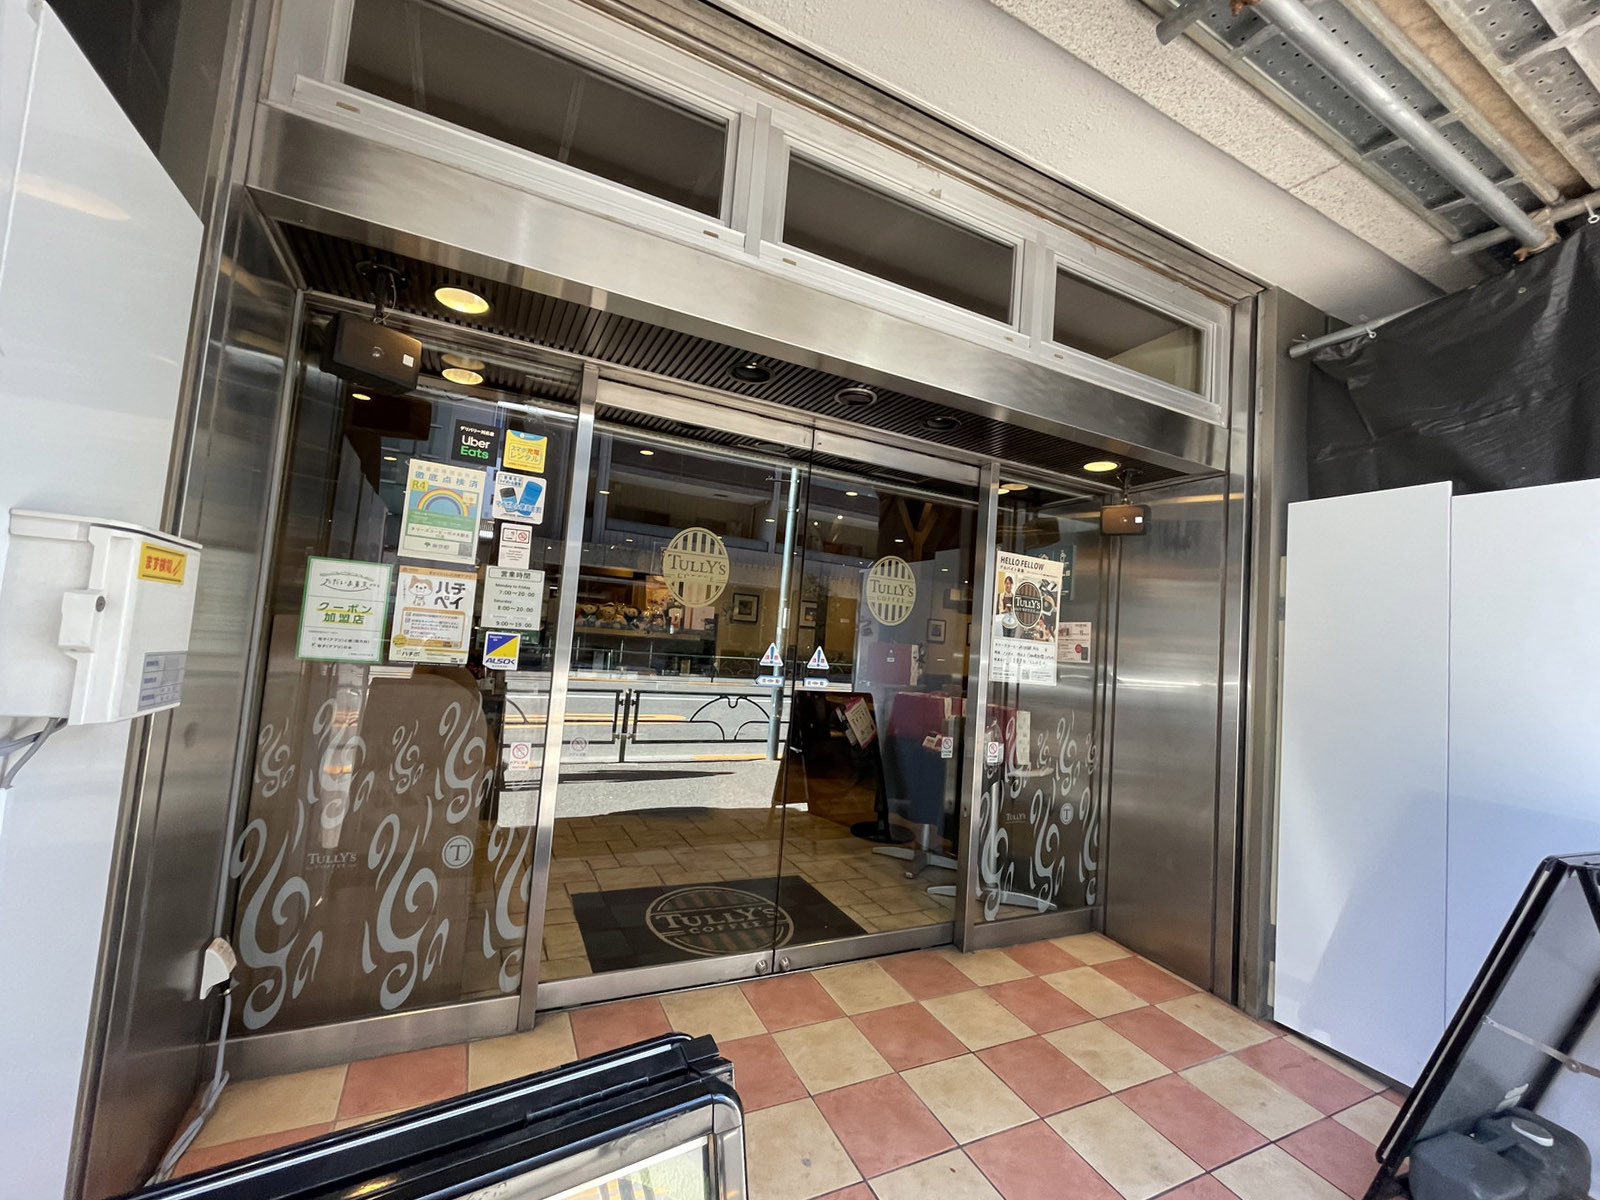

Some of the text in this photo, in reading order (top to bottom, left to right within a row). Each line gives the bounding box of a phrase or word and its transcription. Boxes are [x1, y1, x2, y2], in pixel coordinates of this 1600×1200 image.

[461, 434, 491, 449] Uber
[460, 445, 489, 460] Eats
[510, 452, 538, 462] レンタル
[412, 480, 426, 490] R4
[668, 554, 726, 576] TULLY'S
[1000, 556, 1045, 570] HELLO FELLOW
[501, 570, 530, 580] 営業時間
[435, 580, 466, 596] ハチ
[870, 579, 914, 598] TULLY'S
[320, 602, 372, 614] クーポン
[434, 596, 464, 610] ペイ
[1016, 596, 1040, 610] TULLY'S
[323, 612, 365, 624] 加盟店
[307, 852, 358, 864] TULLY'S
[451, 844, 468, 861] T
[656, 906, 780, 928] TULLY'S
[688, 920, 761, 934] COFFEE
